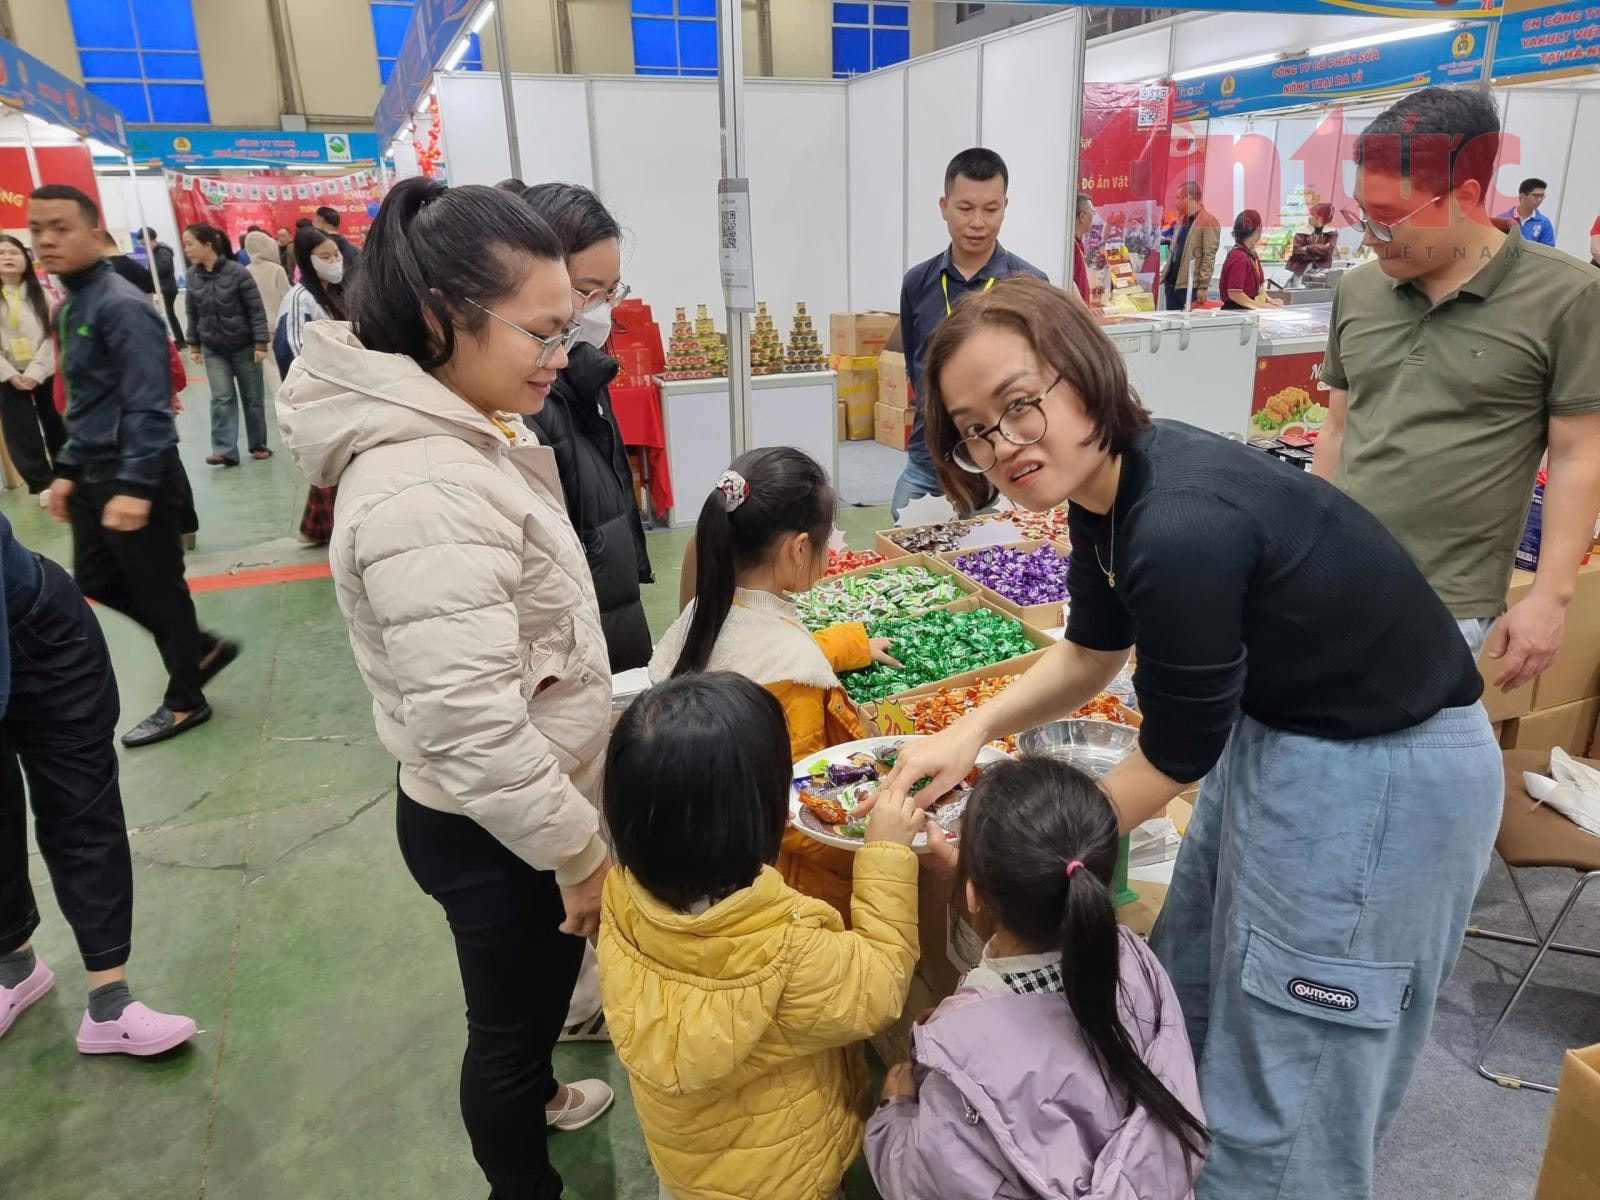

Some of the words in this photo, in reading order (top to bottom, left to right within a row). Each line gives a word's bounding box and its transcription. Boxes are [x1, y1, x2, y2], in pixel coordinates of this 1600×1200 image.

[1480, 0, 1495, 11] 28
[1544, 10, 1583, 27] CÔNG
[1521, 31, 1570, 49] YAKULT
[1541, 50, 1561, 65] TẠI
[1563, 44, 1583, 61] HÀ
[1272, 64, 1297, 78] CÔNG
[1299, 62, 1311, 73] TY
[1283, 80, 1309, 94] NÔNG
[1334, 73, 1350, 86] BA
[1082, 174, 1095, 189] Đồ
[1112, 175, 1129, 190] Vặt
[1295, 984, 1351, 1007] OUTDOOR
